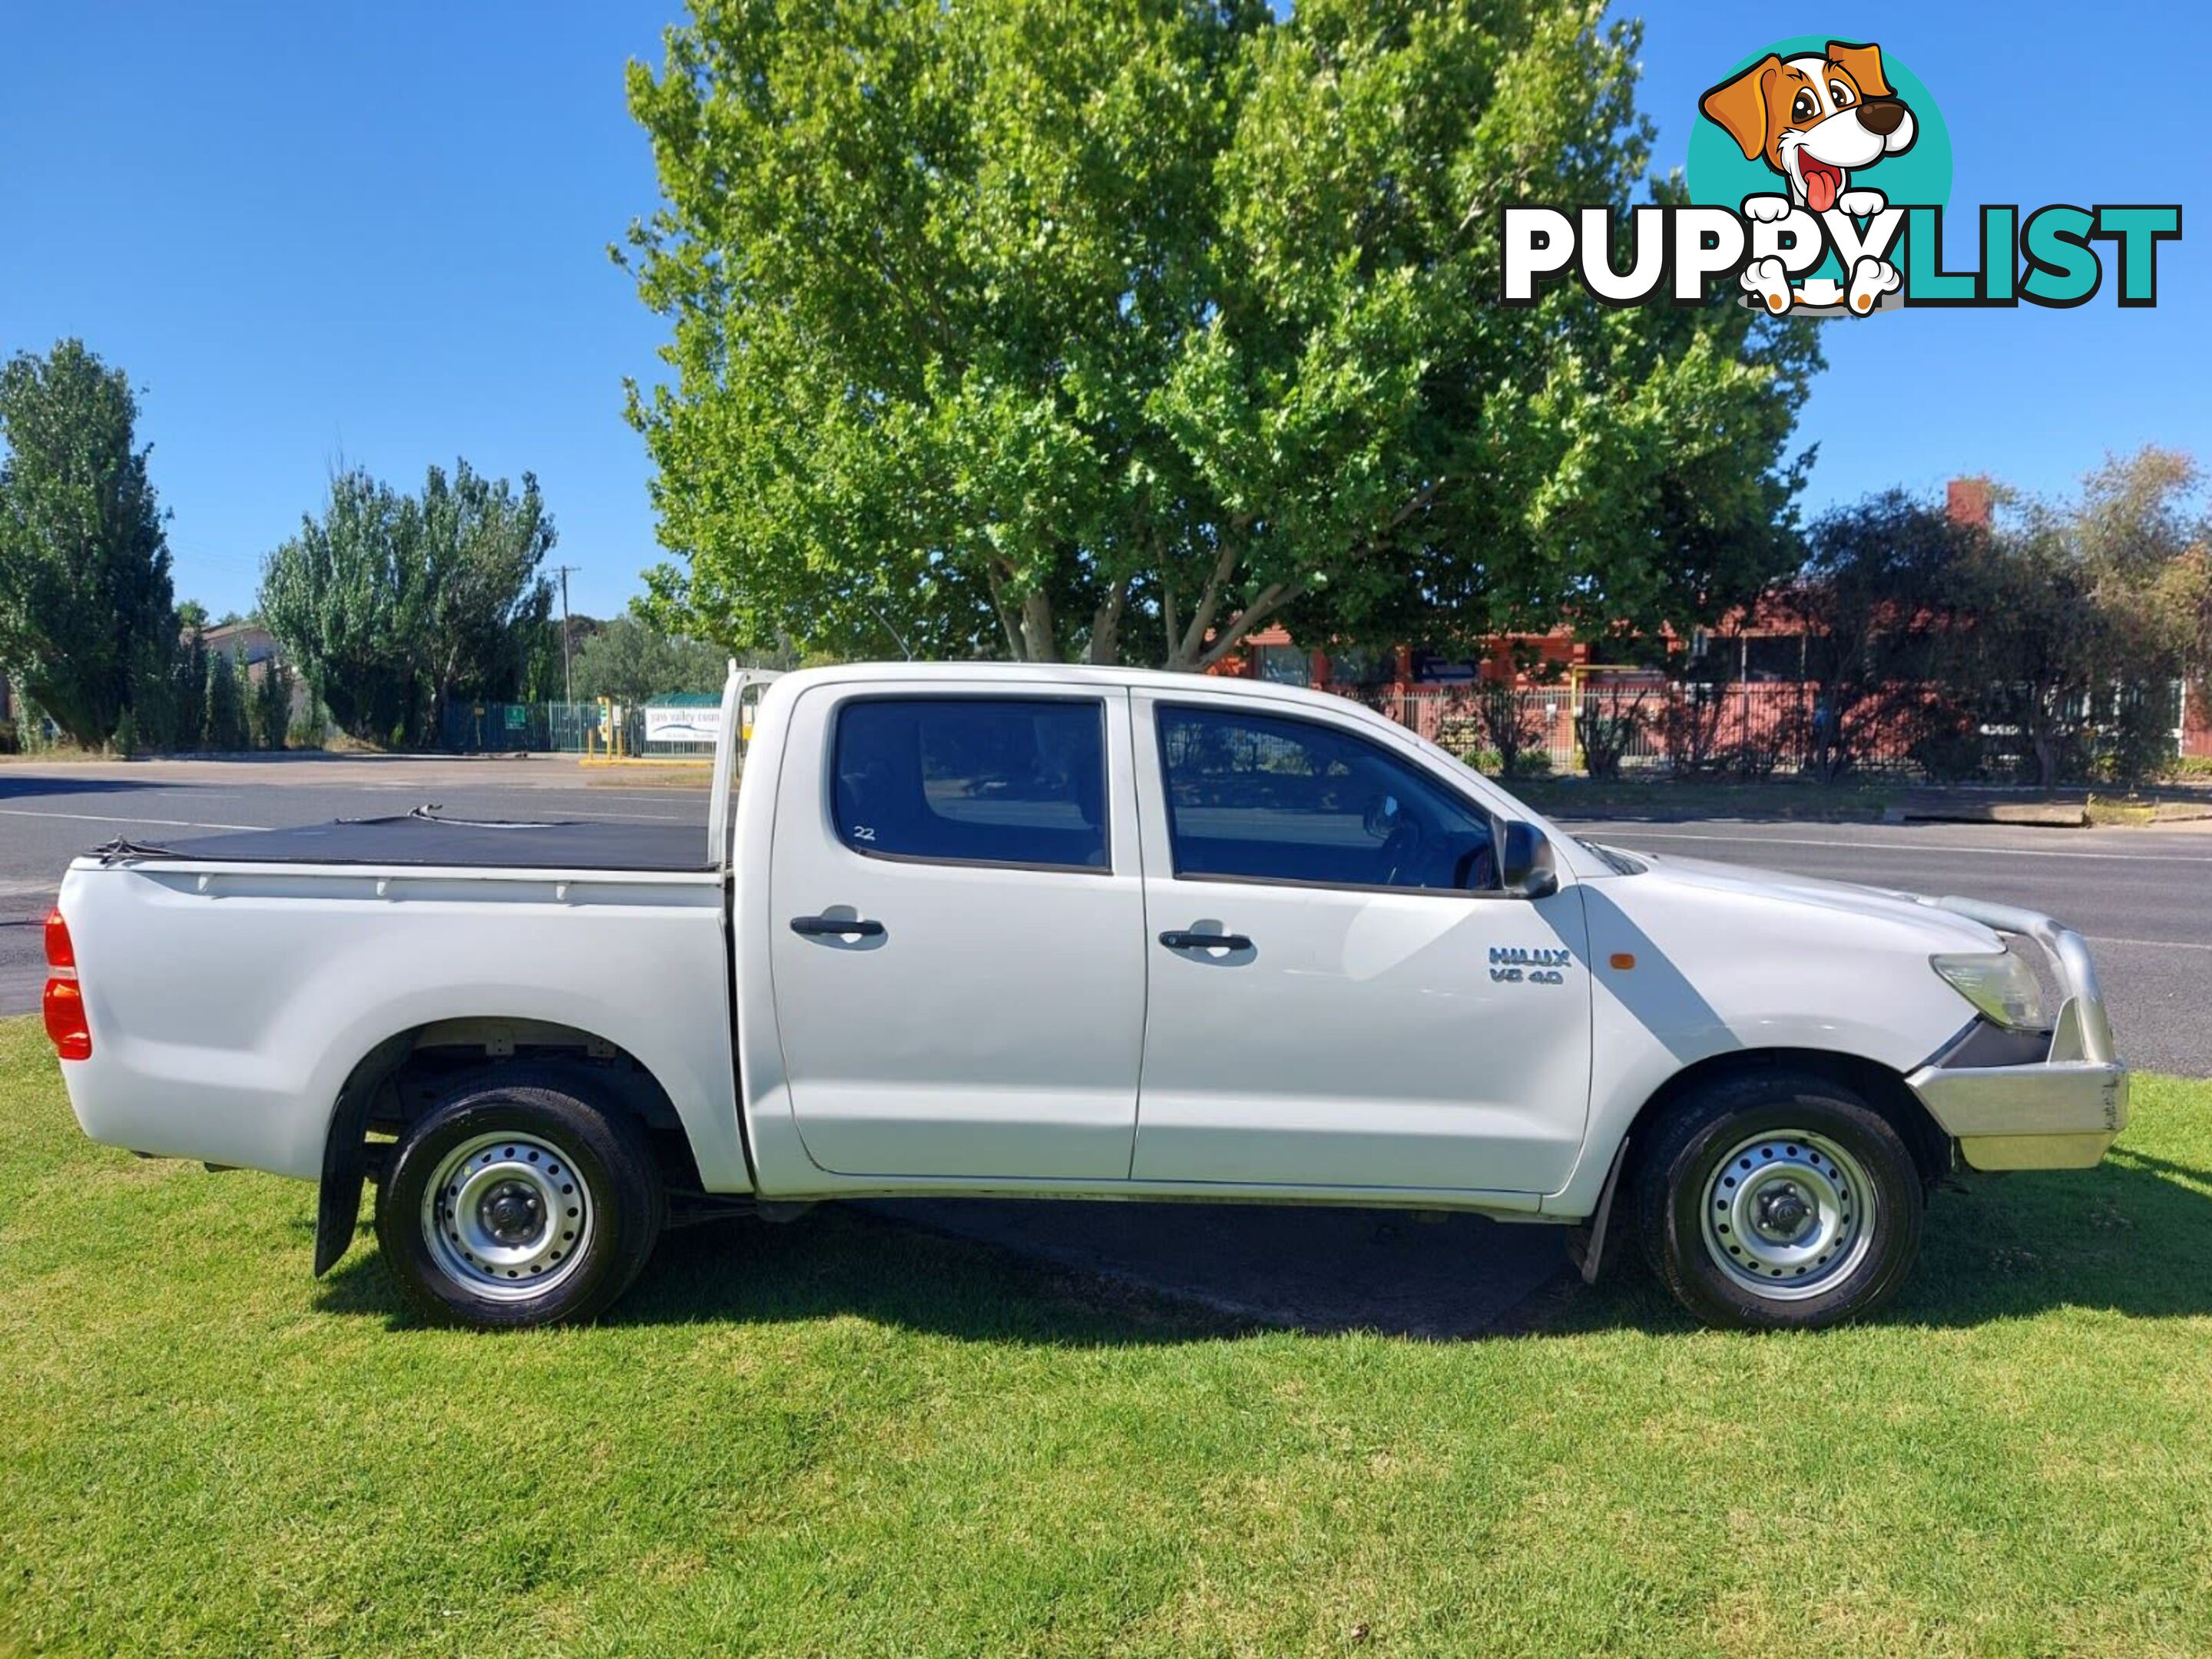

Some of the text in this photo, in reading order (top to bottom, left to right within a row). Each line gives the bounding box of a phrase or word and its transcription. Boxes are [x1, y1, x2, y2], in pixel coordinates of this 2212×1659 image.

[670, 710, 695, 724] valley
[854, 826, 875, 841] 22
[1489, 948, 1571, 967] HILUX
